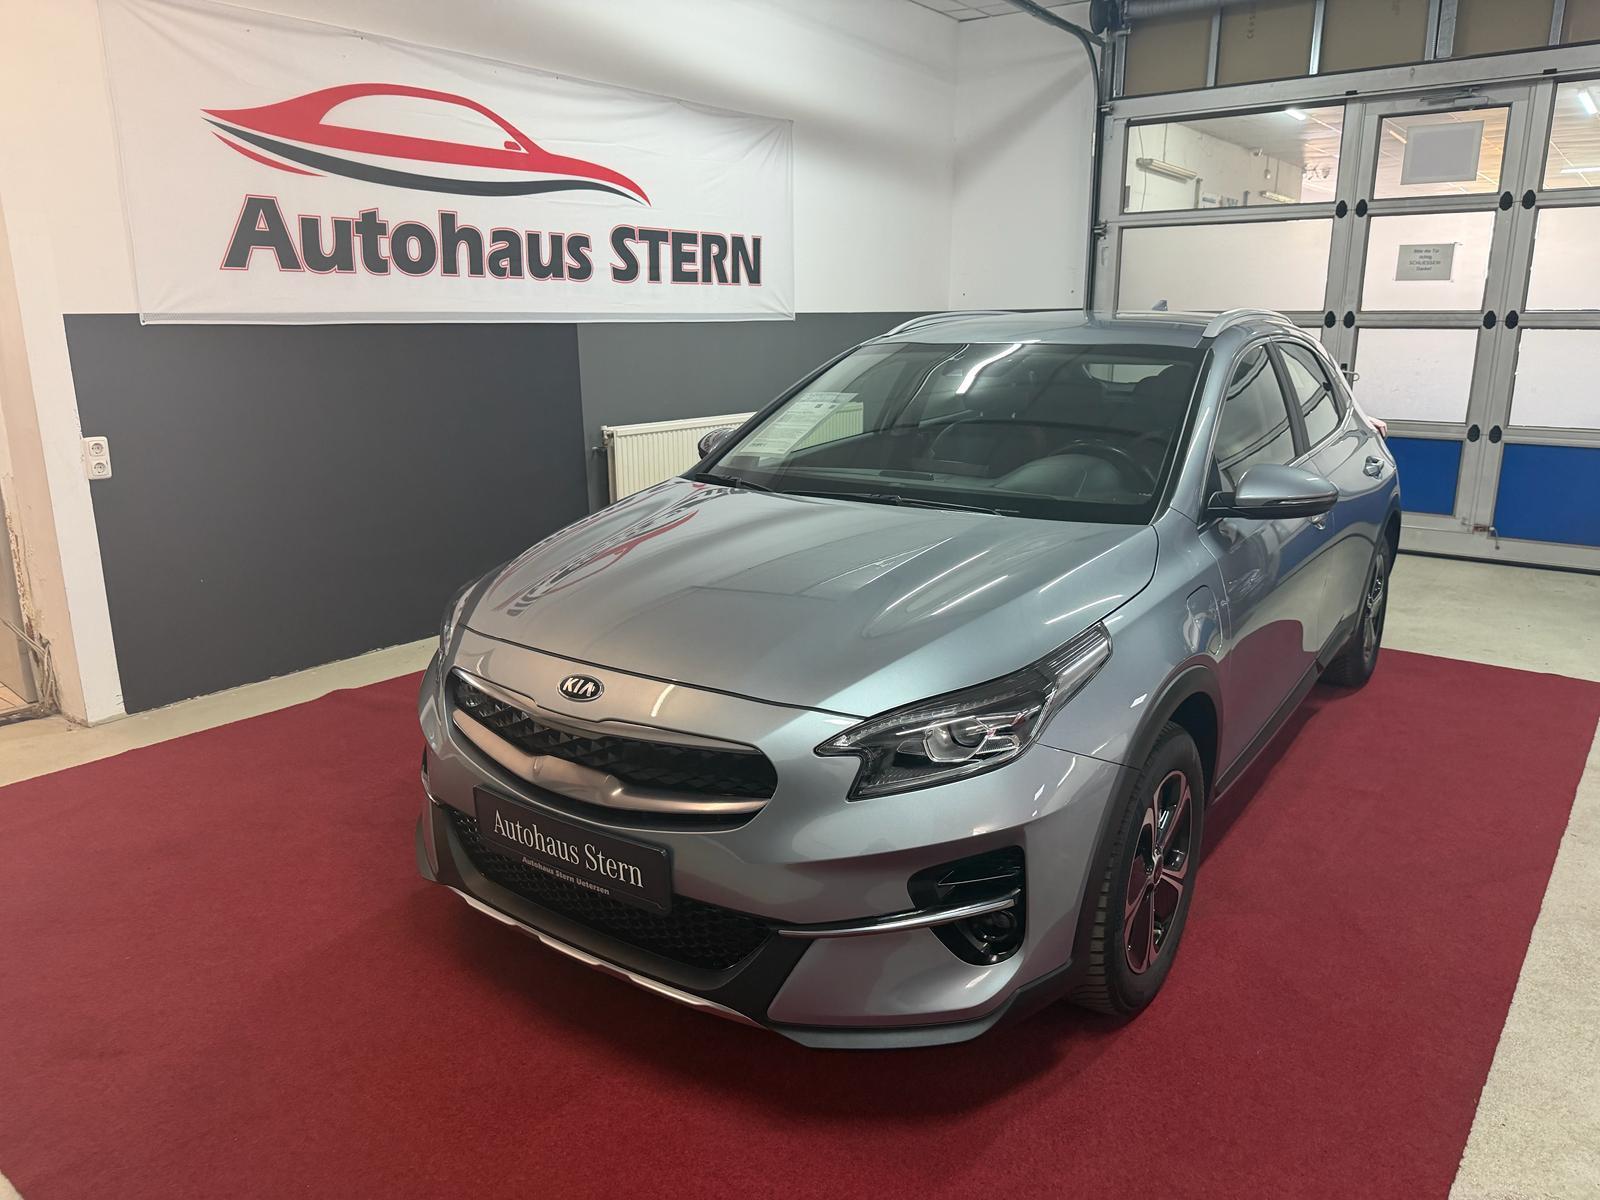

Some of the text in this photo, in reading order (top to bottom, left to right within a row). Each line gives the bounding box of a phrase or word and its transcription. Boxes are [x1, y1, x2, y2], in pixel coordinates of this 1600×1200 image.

[220, 193, 762, 287] Autohaus STERN
[562, 677, 595, 696] KIA
[494, 809, 644, 888] Autohaus Stern
[522, 856, 611, 895] Autohaus Stern Uetersen
